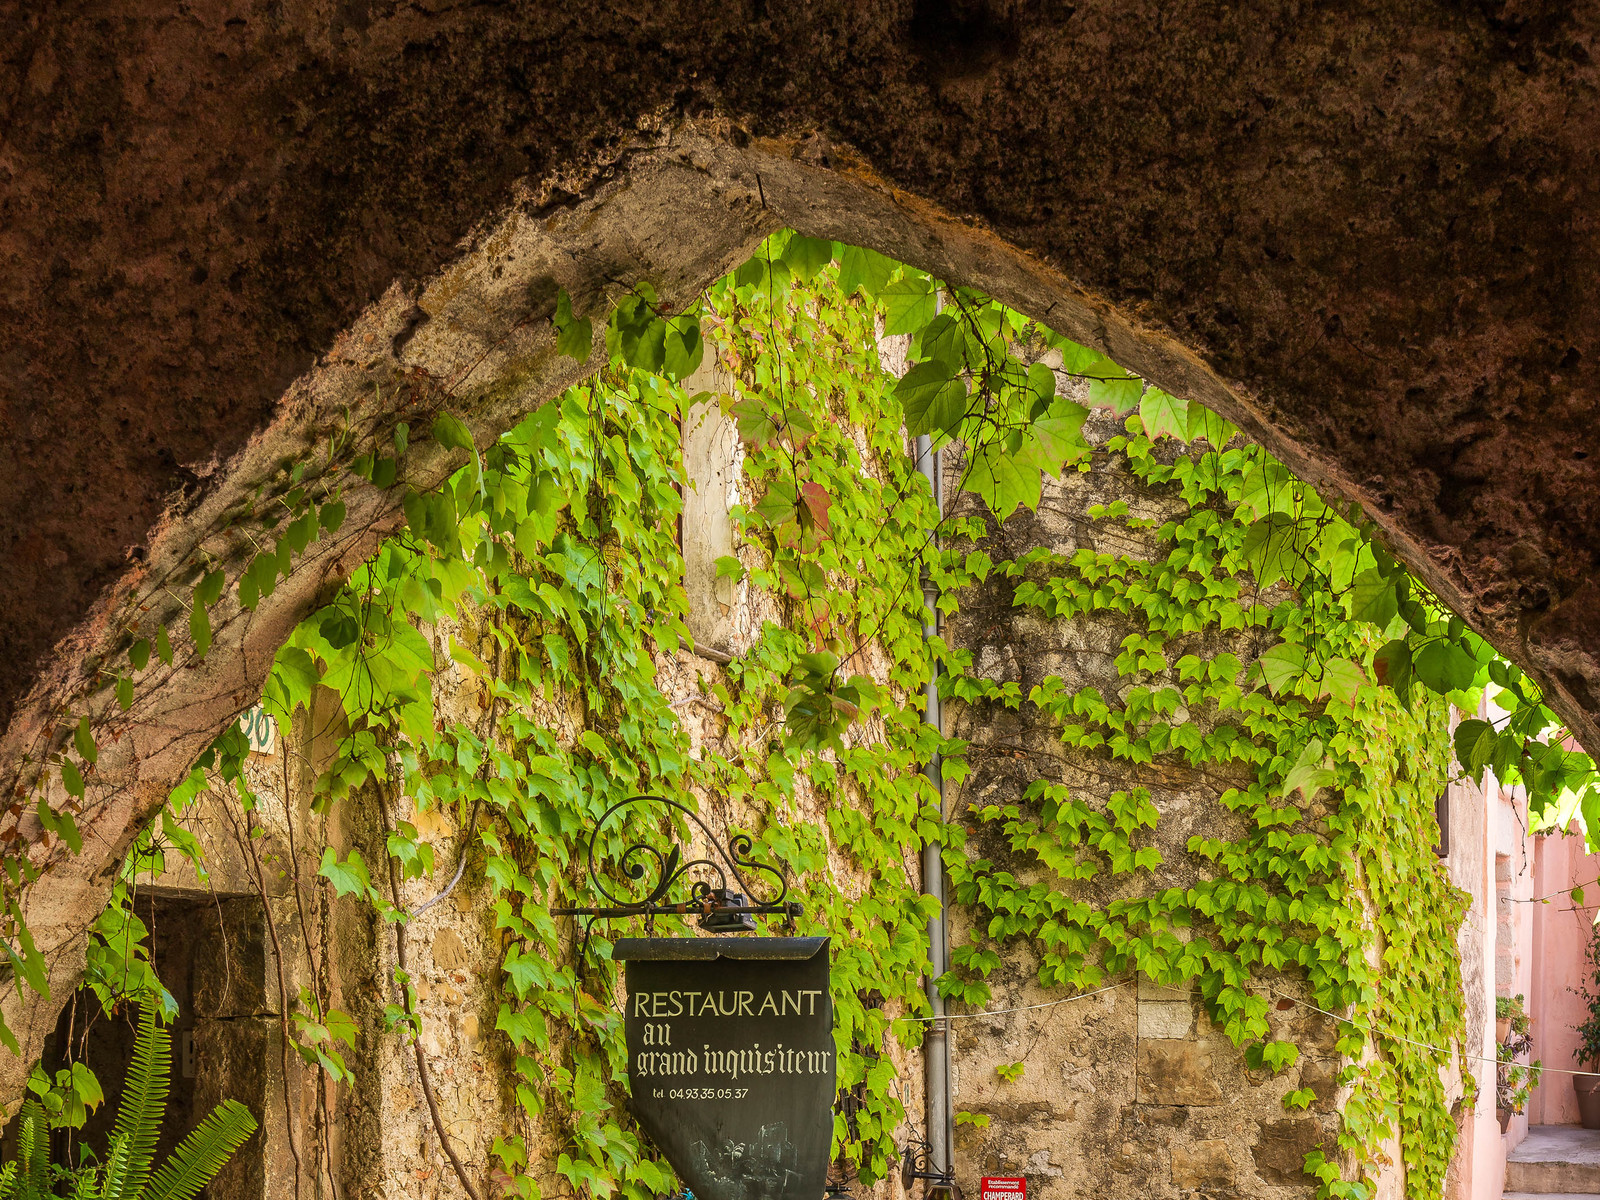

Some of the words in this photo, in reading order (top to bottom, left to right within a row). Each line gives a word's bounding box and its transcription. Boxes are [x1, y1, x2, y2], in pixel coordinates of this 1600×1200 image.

[634, 990, 822, 1018] RESTAURANT
[643, 1022, 672, 1046] au
[636, 1048, 698, 1078] grand
[703, 1043, 832, 1080] inquisiteur
[669, 1088, 749, 1100] 04.93.35.05.37
[983, 1191, 1024, 1200] CHAMPERARD
